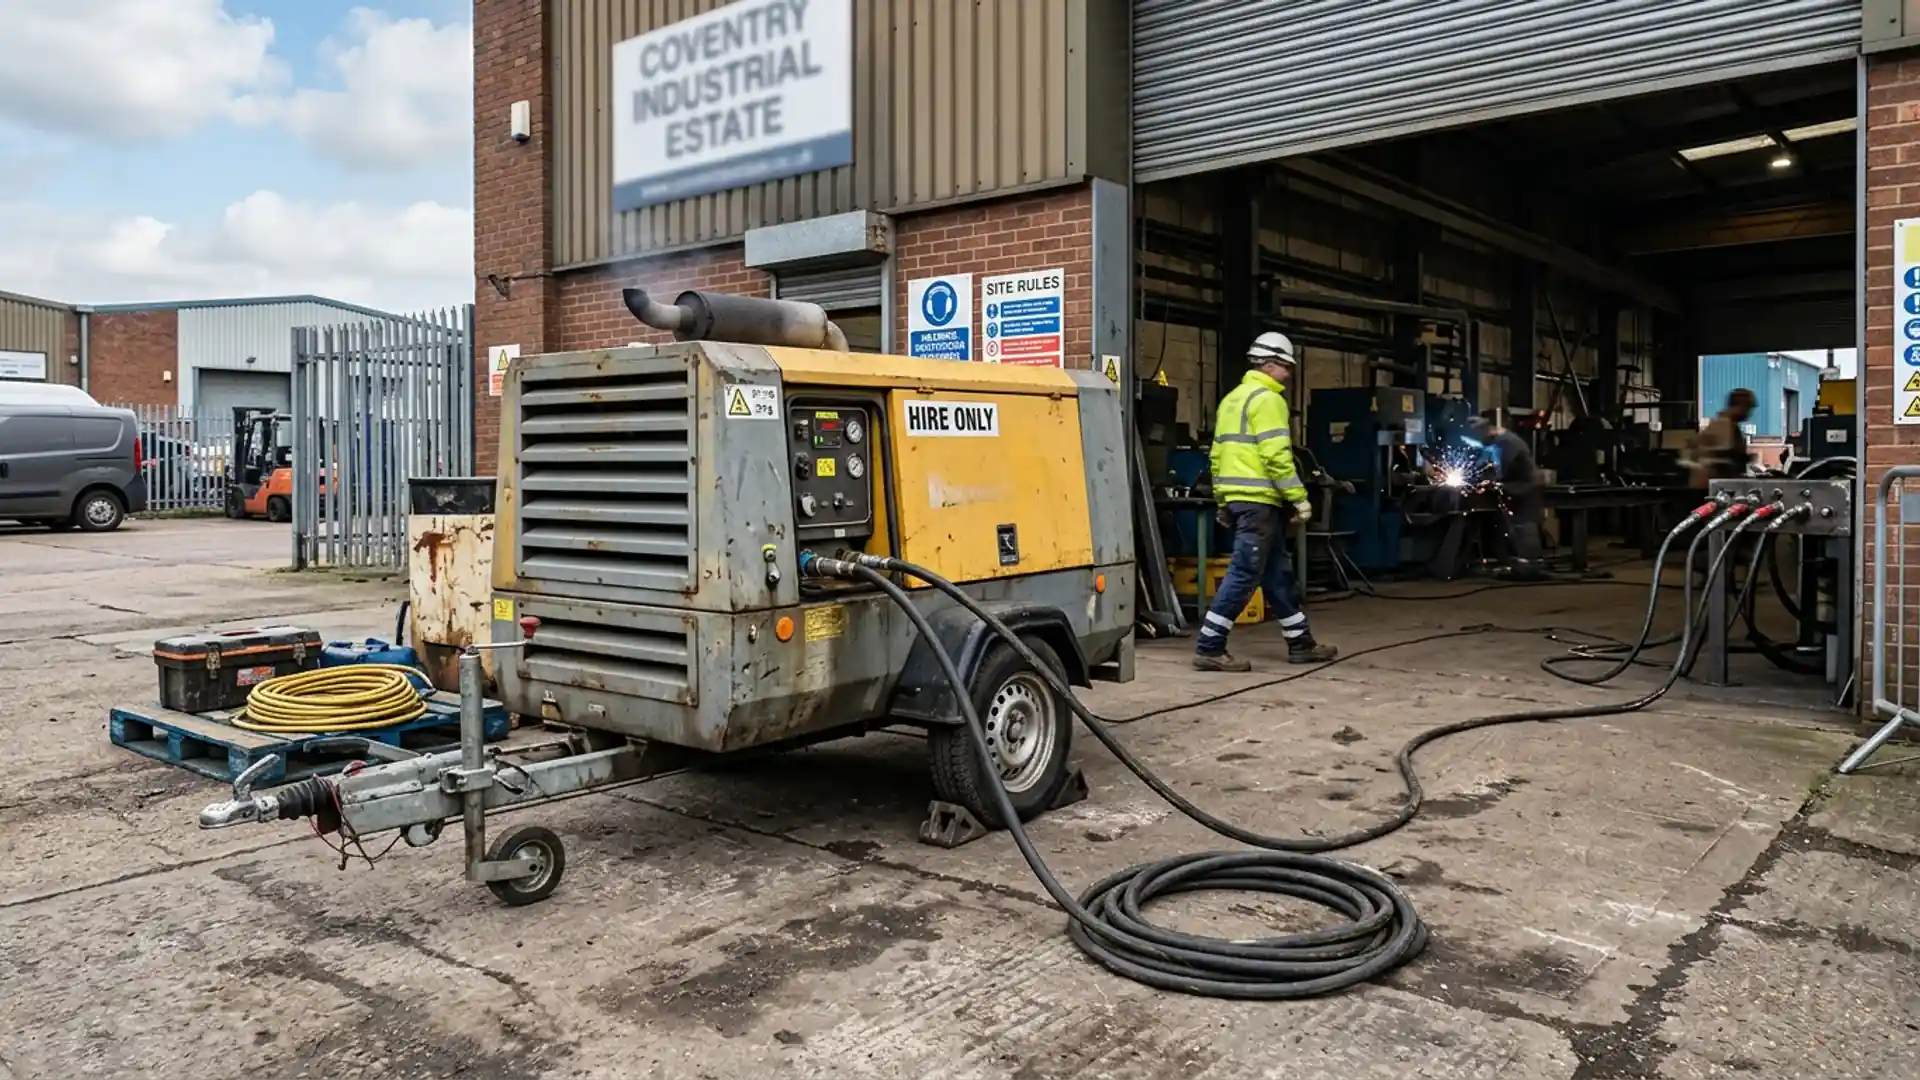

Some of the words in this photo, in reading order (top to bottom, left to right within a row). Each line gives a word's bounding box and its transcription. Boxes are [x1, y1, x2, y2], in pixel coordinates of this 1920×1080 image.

[640, 0, 808, 79] COVENTRY
[633, 39, 822, 125] INDUSTRIAL
[665, 95, 783, 158] ESTATE
[986, 281, 1014, 296] SITE
[1017, 275, 1060, 293] RULES
[908, 405, 950, 430] HIRE
[954, 406, 993, 431] ONLY
